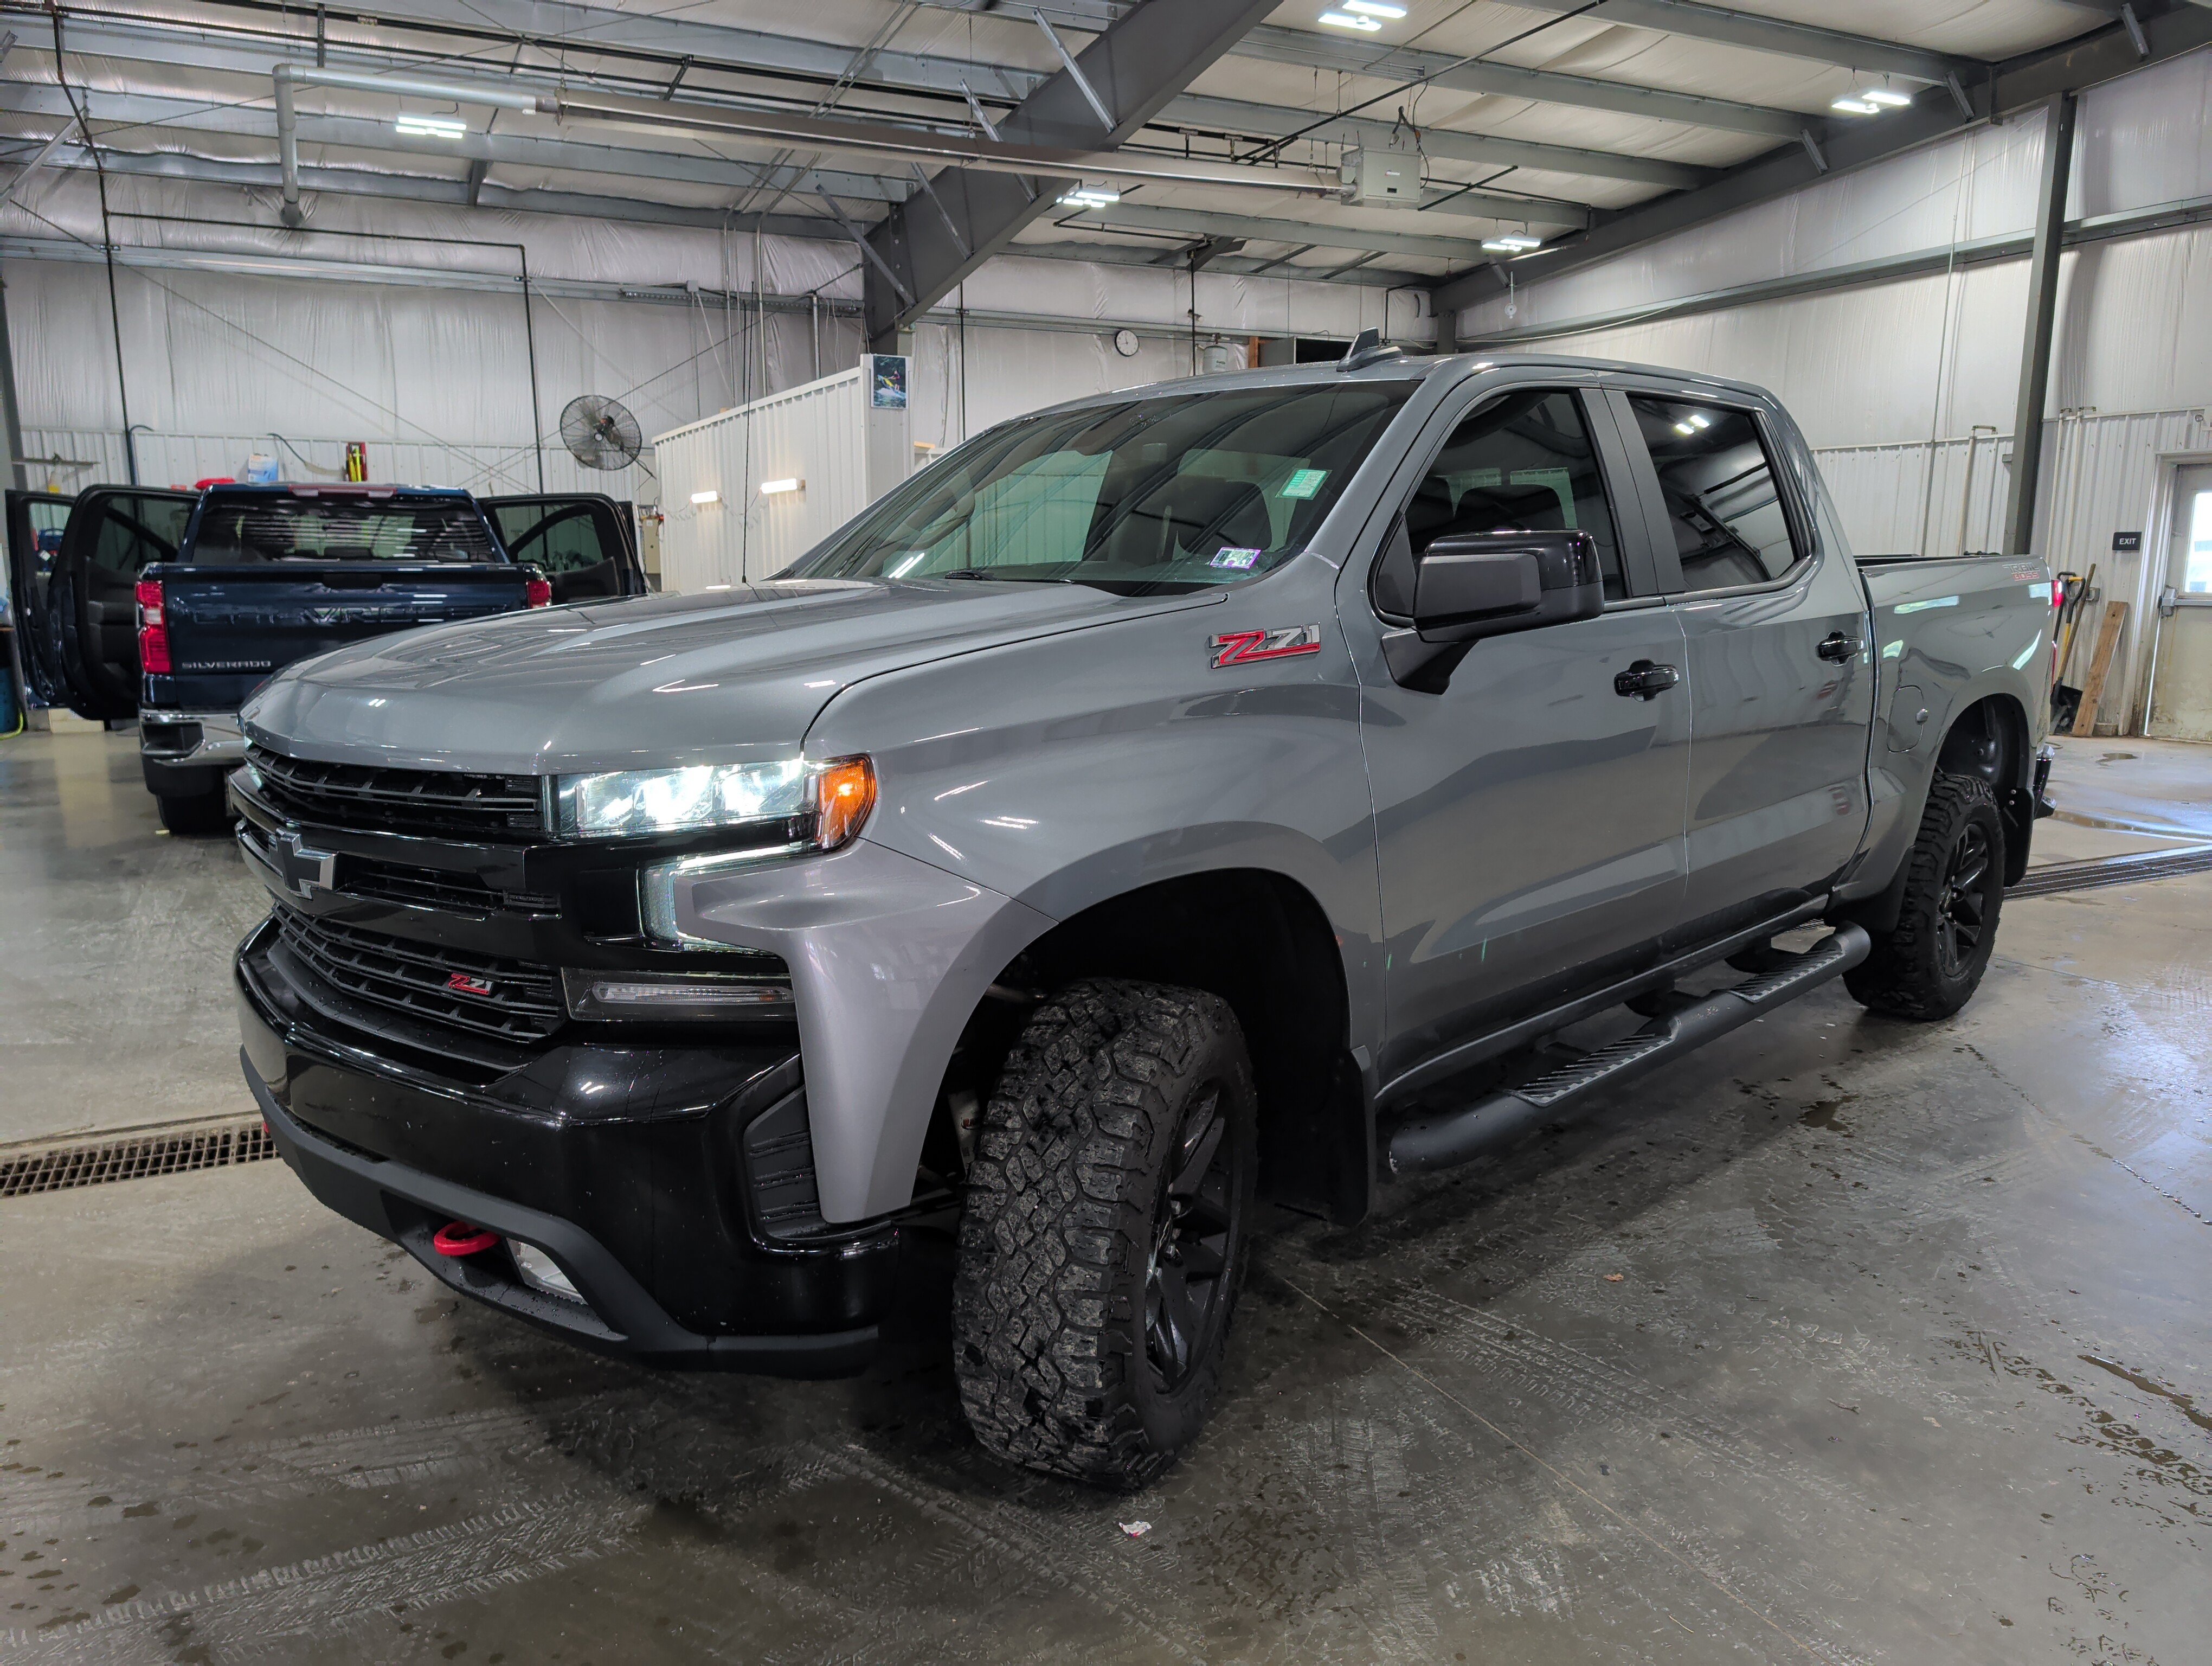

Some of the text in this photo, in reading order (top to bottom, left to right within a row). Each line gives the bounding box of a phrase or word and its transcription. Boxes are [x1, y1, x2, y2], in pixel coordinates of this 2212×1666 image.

[2002, 562, 2040, 573] TRAIL
[2012, 572, 2040, 581] BOSS
[1210, 622, 1321, 669] Z71
[182, 660, 271, 669] SILVERADO
[448, 973, 493, 995] Z71
